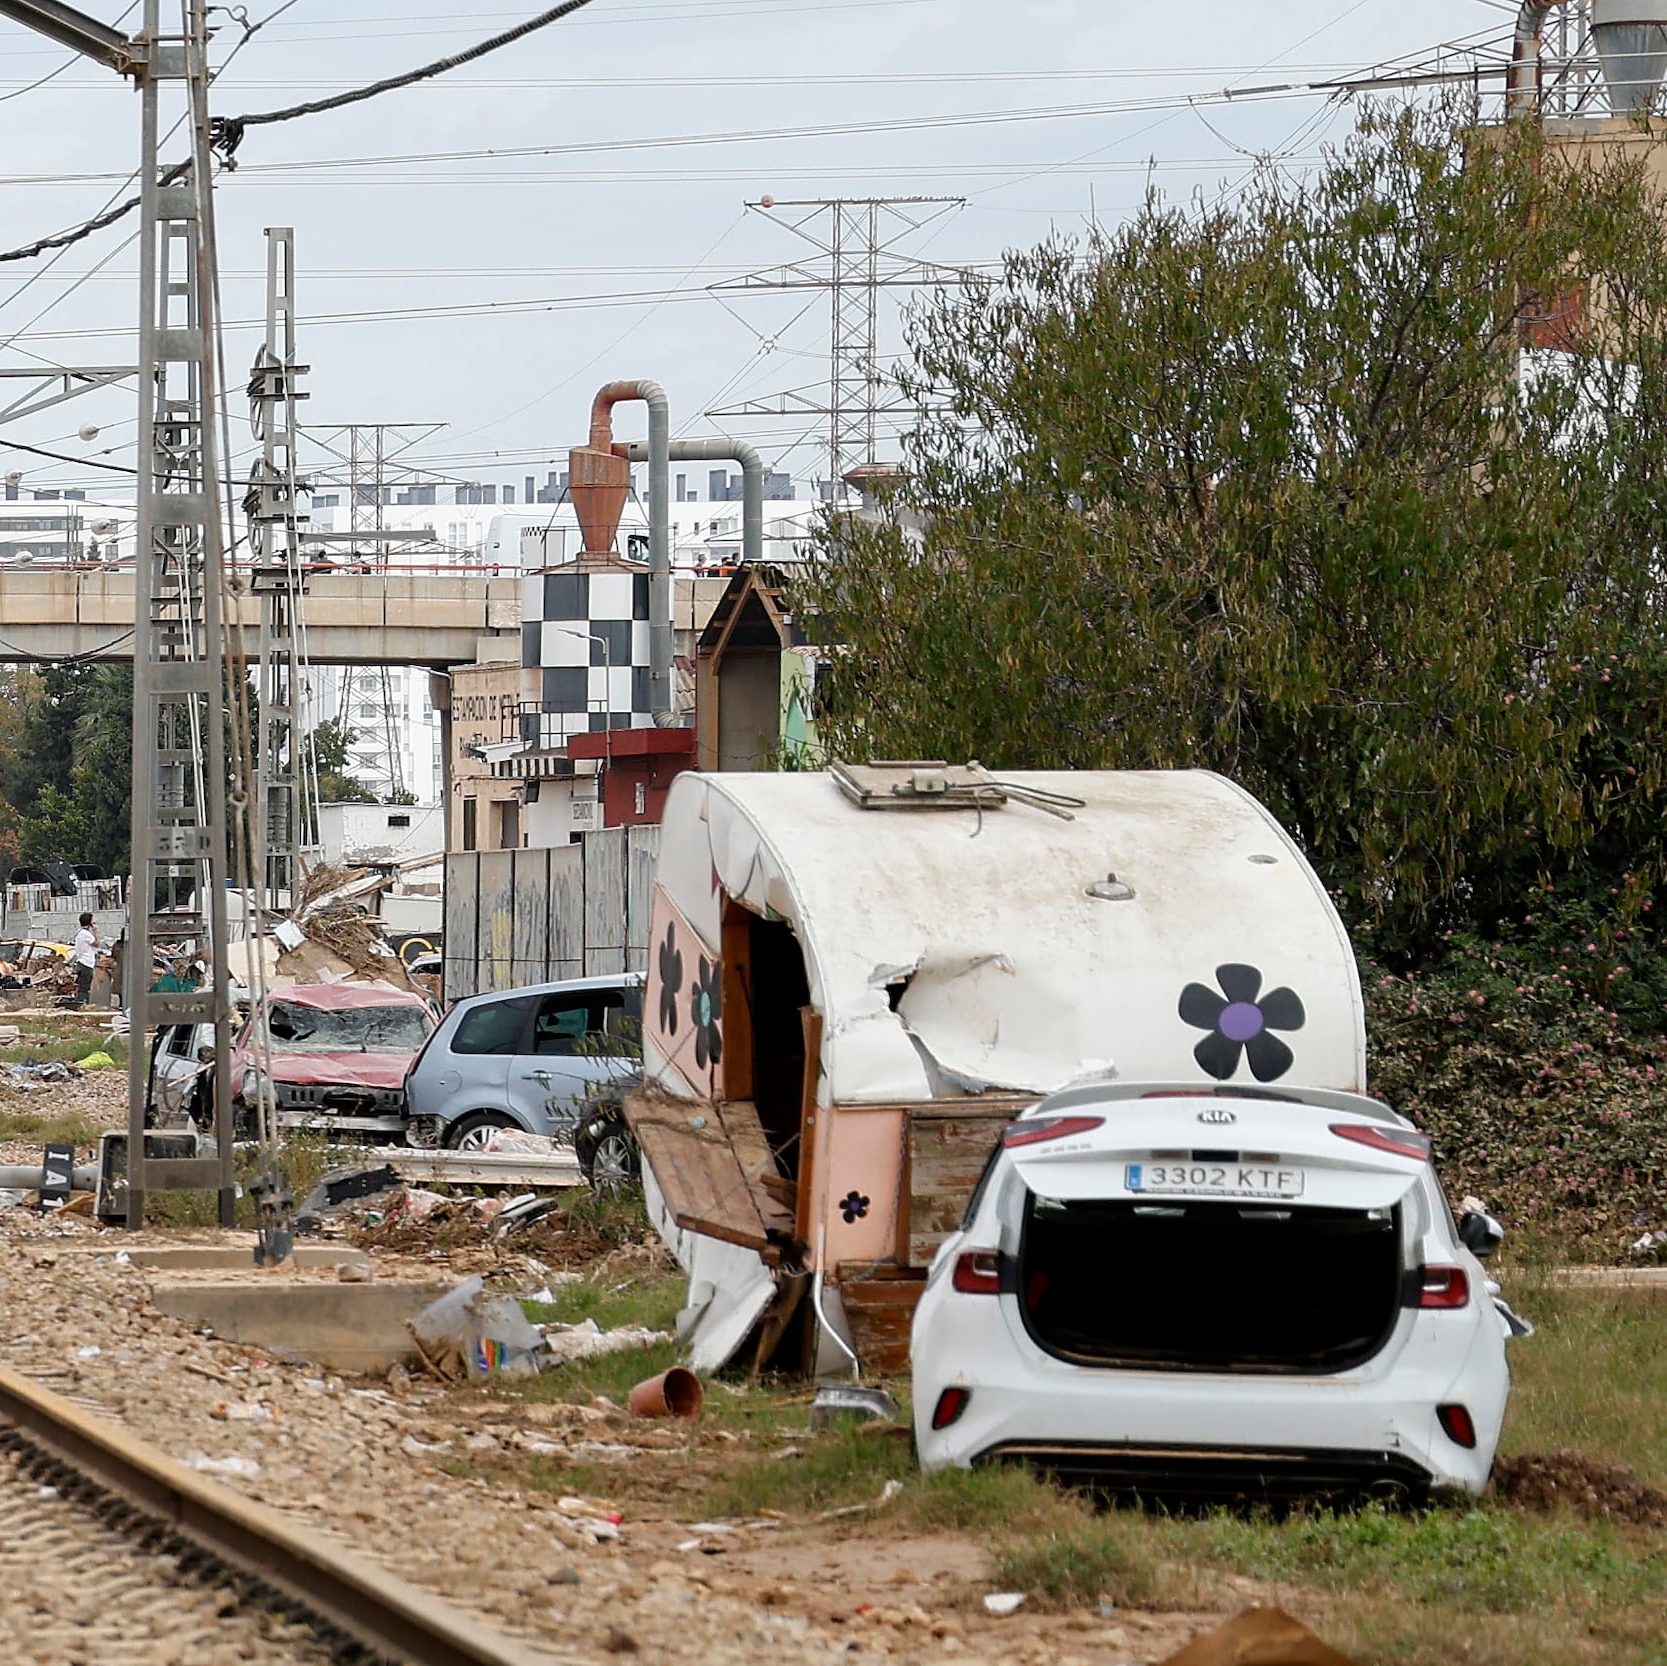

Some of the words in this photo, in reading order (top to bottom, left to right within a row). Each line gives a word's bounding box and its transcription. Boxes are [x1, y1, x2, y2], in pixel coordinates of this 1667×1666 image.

[1201, 1110, 1233, 1123] KIA
[1151, 1166, 1227, 1187] 3302
[1237, 1169, 1295, 1189] KTF
